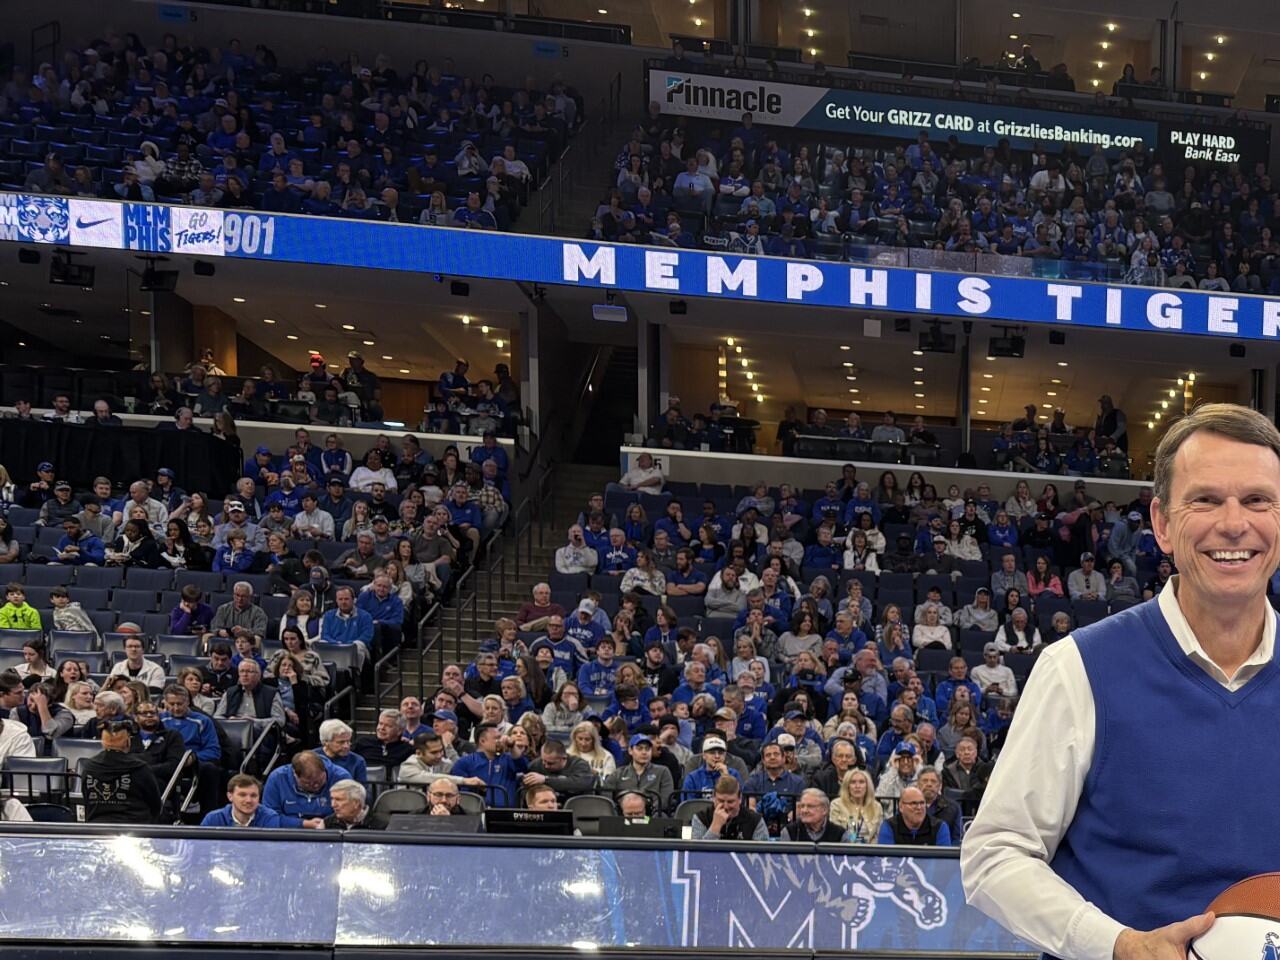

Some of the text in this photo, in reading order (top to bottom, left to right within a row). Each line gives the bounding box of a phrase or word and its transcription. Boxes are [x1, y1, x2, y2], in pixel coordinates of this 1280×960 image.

[666, 76, 782, 115] Pinnacle
[825, 102, 851, 120] Get
[855, 106, 884, 123] Your
[887, 109, 931, 128] GRIZZ
[935, 113, 973, 132] CARD
[977, 120, 990, 134] at
[1171, 131, 1235, 149] PLAY HARD
[1185, 146, 1212, 162] Bank
[189, 212, 208, 228] GO
[175, 226, 222, 247] TIGERS!
[223, 214, 275, 254] 901
[563, 243, 991, 314] MEMPHIS
